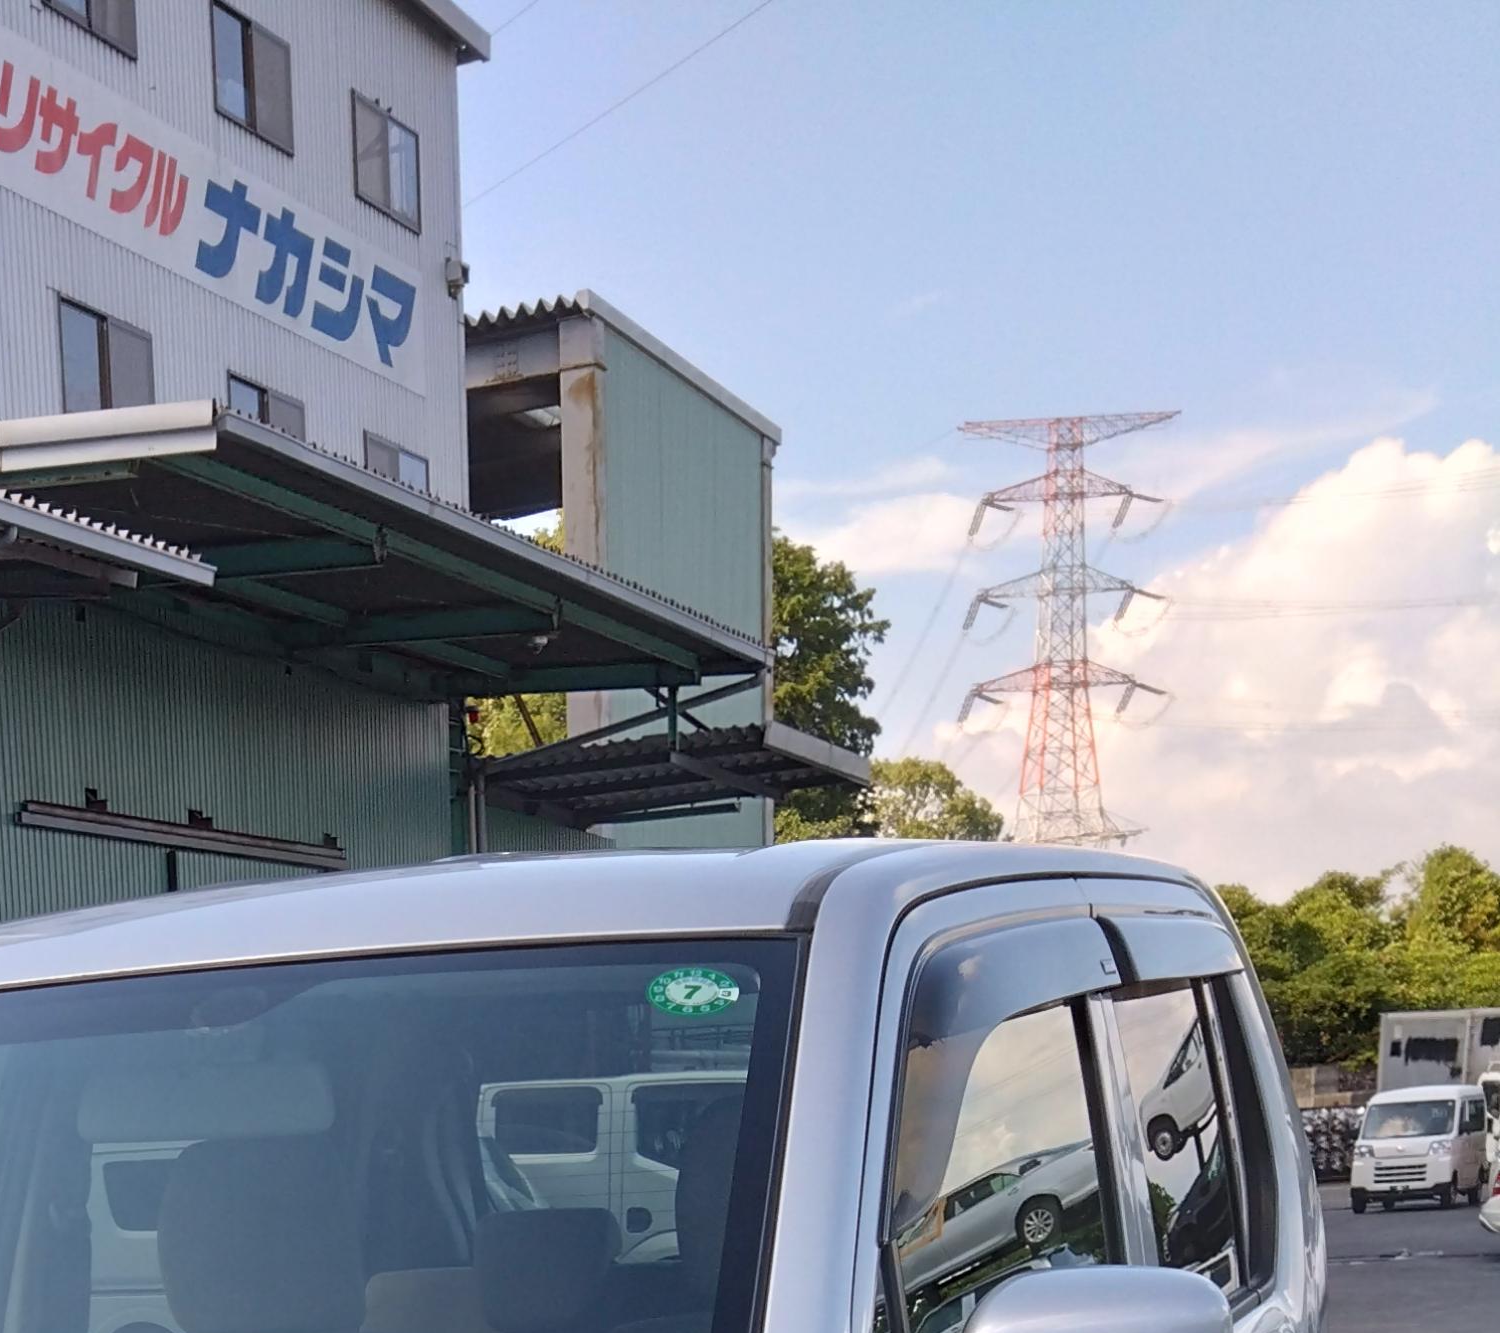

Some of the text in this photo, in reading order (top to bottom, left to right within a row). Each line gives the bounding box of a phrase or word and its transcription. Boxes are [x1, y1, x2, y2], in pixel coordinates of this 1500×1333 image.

[195, 179, 416, 368] ナカシマ
[683, 984, 702, 1000] 7
